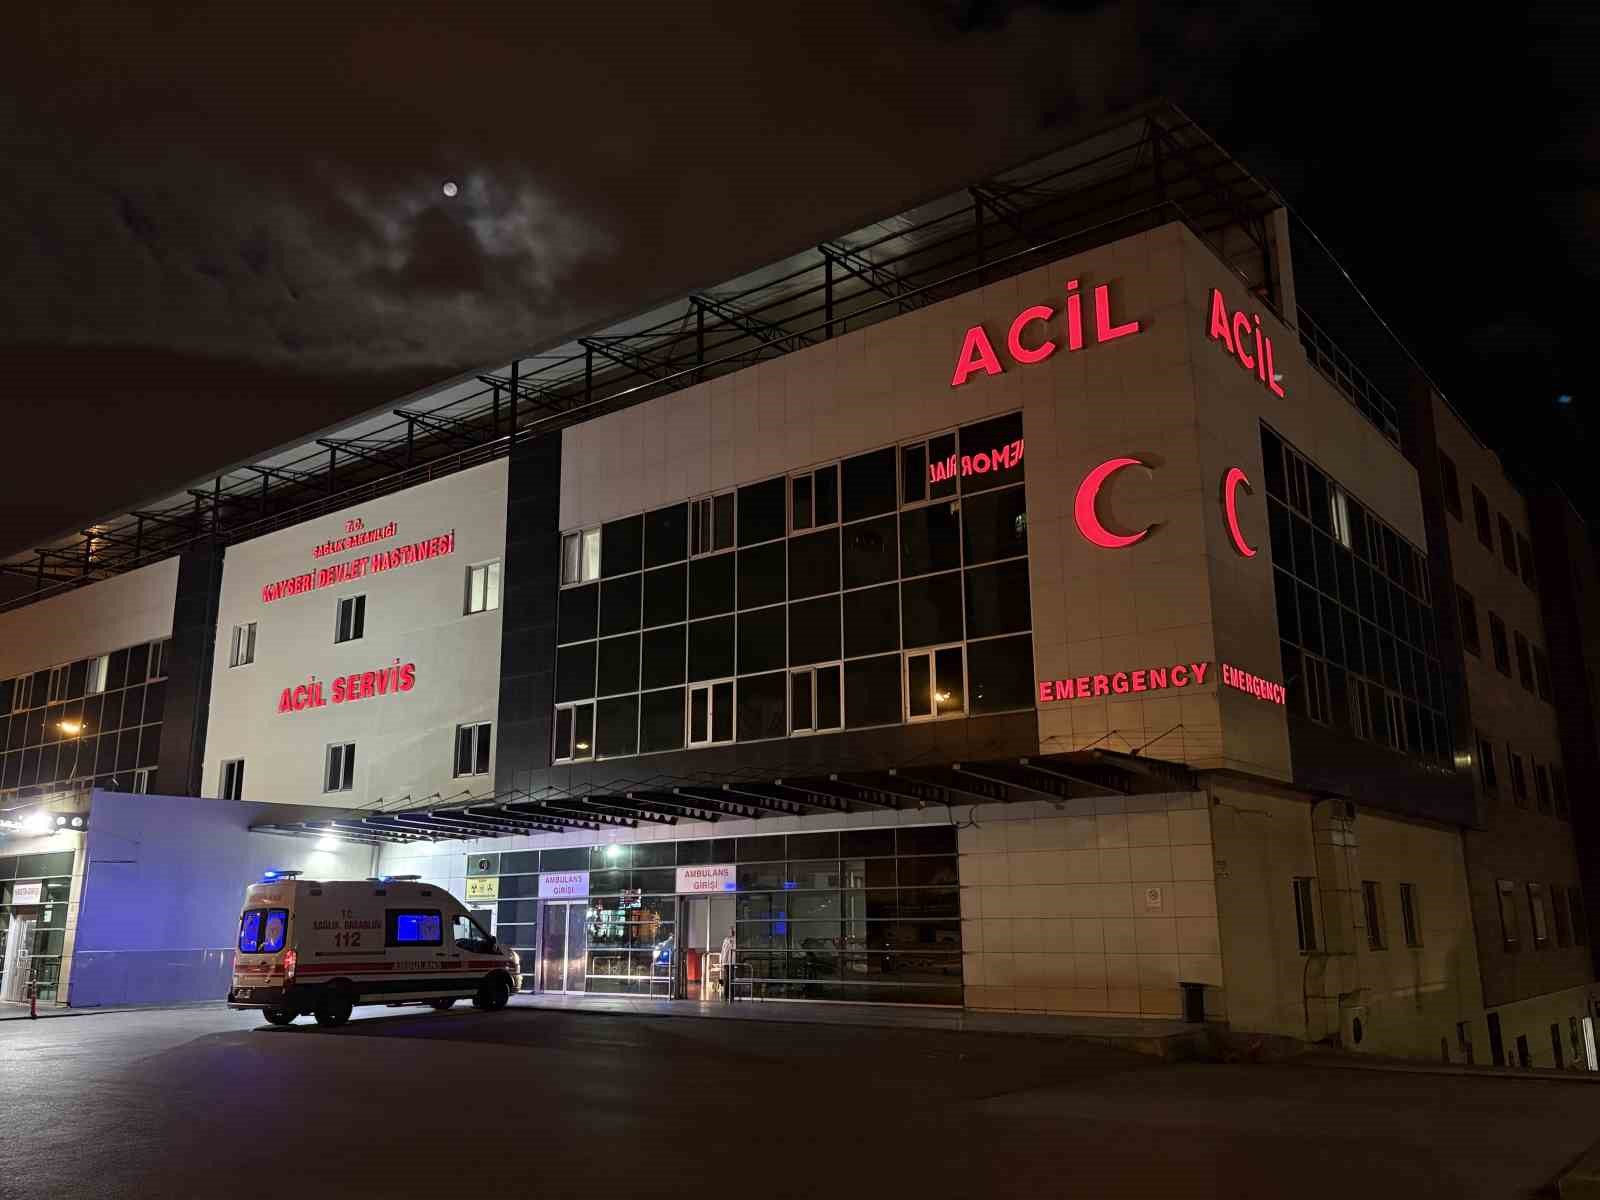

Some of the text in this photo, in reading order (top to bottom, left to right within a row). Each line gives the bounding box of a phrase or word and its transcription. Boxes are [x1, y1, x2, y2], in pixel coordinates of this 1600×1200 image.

[951, 279, 1141, 386] ACİL
[1211, 287, 1285, 398] ACİL
[261, 529, 455, 603] KAYSERİ DEVLET HASTANESİ
[277, 658, 416, 714] ACİL SERVİS
[1039, 663, 1208, 702] EMERGENCY
[1222, 663, 1286, 704] EMERGENCY
[545, 875, 582, 884] AMBULANS
[684, 868, 729, 878] AMBULANS
[333, 932, 361, 947] 112
